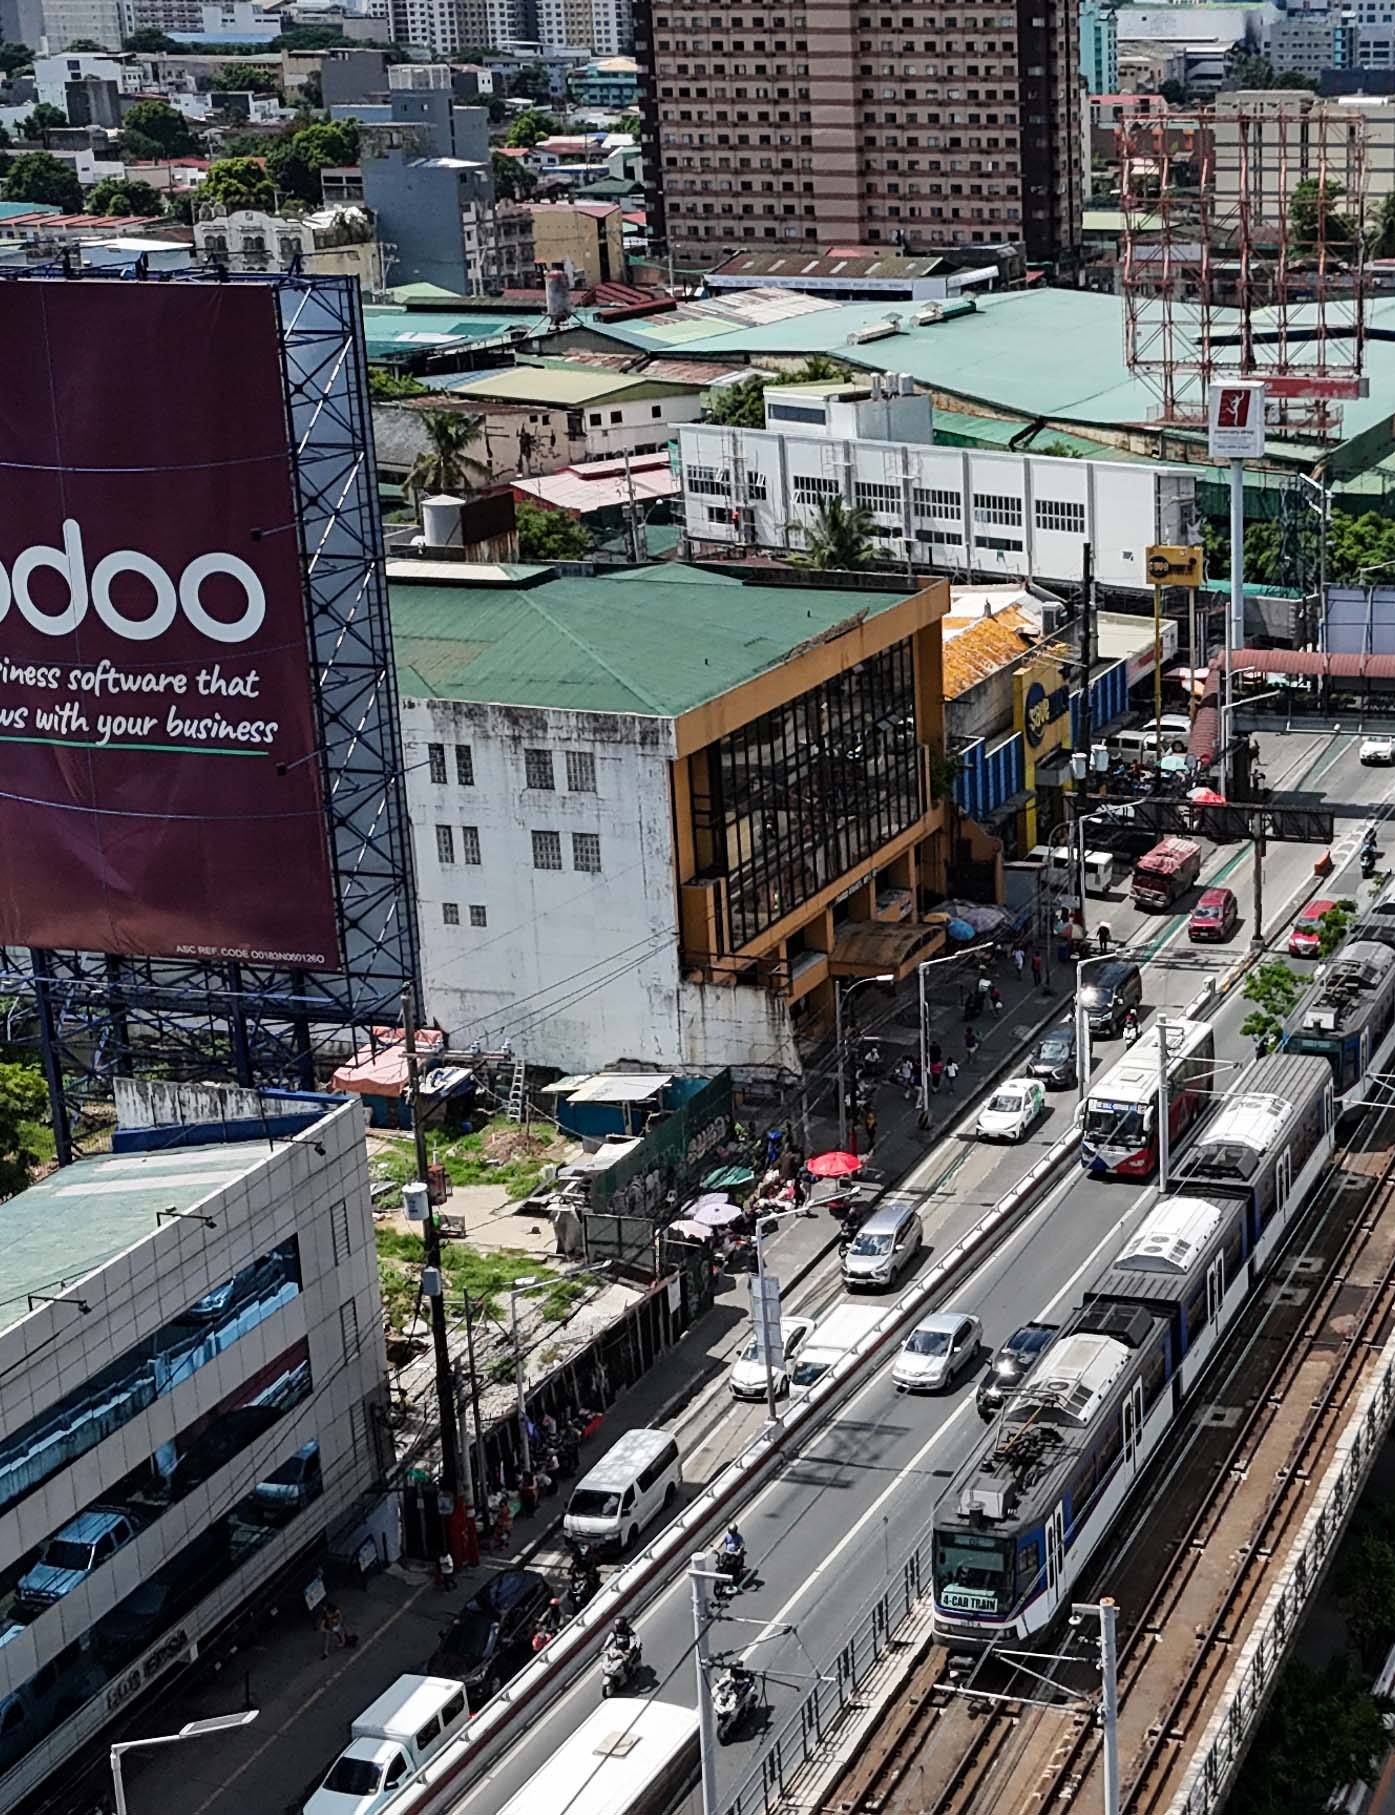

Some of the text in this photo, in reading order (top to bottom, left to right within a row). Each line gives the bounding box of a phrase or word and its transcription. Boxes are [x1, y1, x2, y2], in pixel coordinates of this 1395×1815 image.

[0, 518, 266, 643] doo
[0, 656, 260, 698] iness software that
[36, 701, 90, 735] with
[95, 713, 159, 746] your
[166, 705, 279, 744] business
[220, 947, 250, 959] CODE
[943, 1594, 997, 1611] 4-CAR TRAIN
